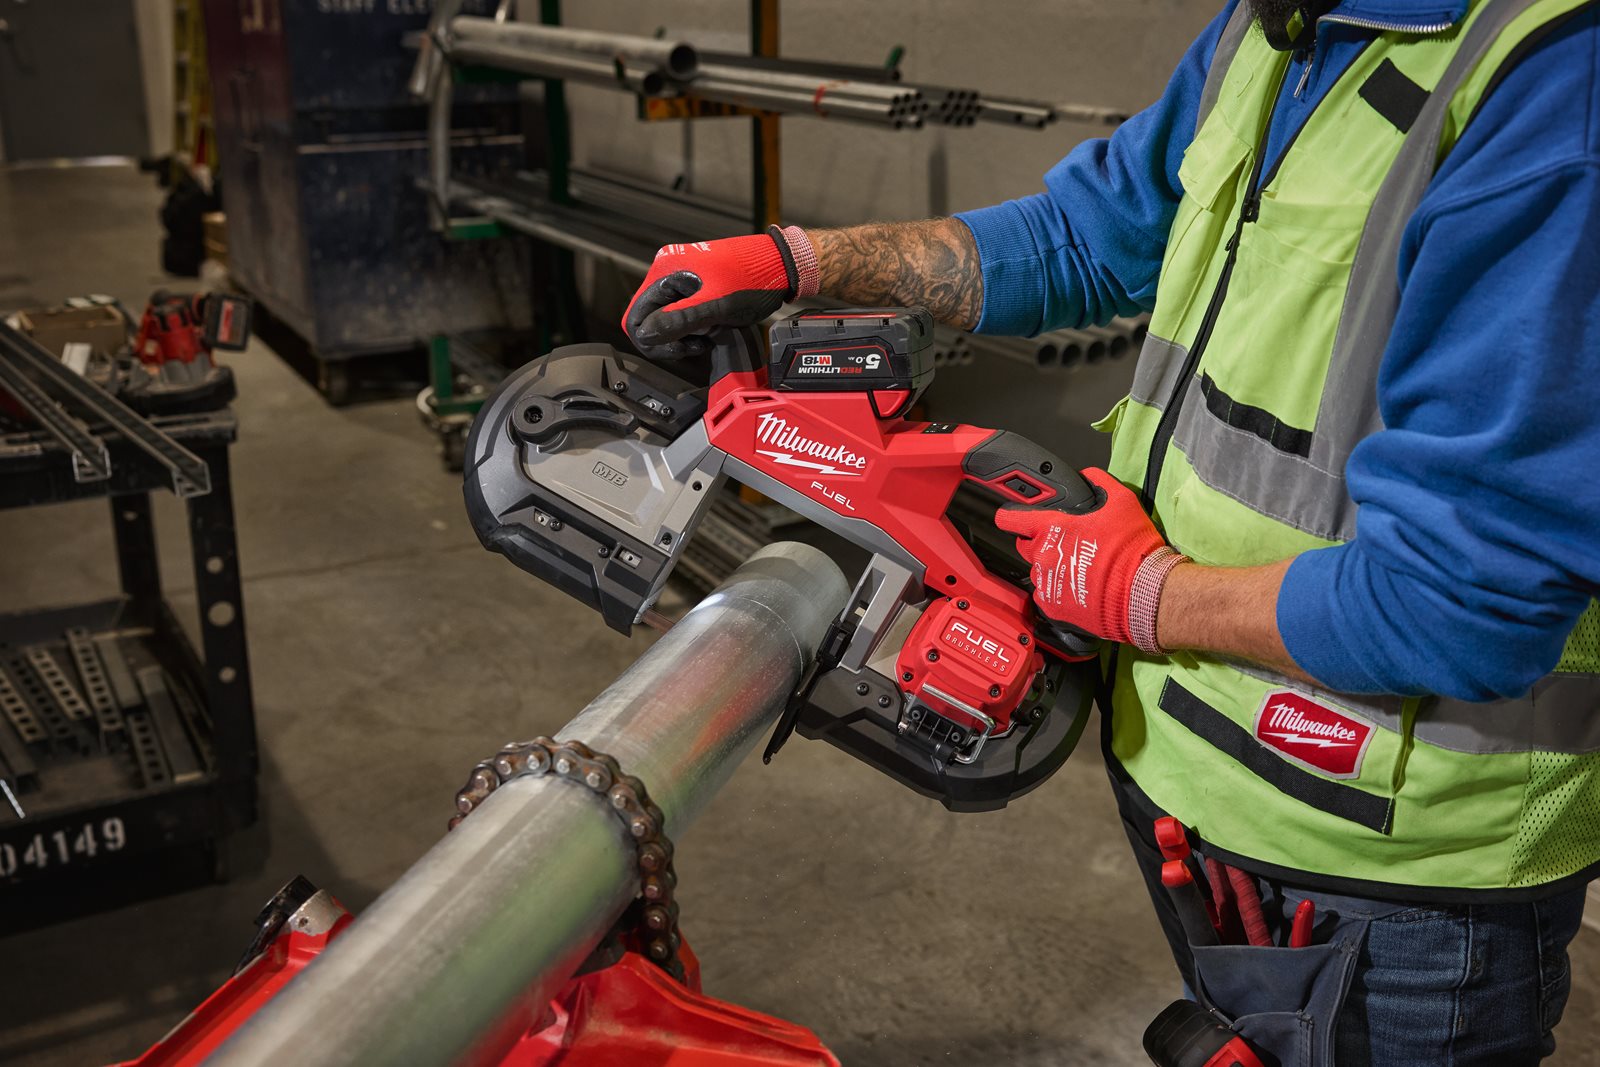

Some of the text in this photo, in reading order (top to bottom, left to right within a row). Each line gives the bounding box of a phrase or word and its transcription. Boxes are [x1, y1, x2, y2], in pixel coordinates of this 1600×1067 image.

[798, 366, 862, 374] REDLITHIUM
[803, 355, 831, 366] M18
[757, 413, 866, 468] Milwaukee
[811, 481, 855, 511] FUEL
[1077, 539, 1098, 606] Milwaukee
[945, 633, 1006, 672] BRUSHLESS
[951, 622, 1010, 663] FUEL
[1270, 703, 1356, 740] Milwaukee
[0, 817, 126, 876] 04149
